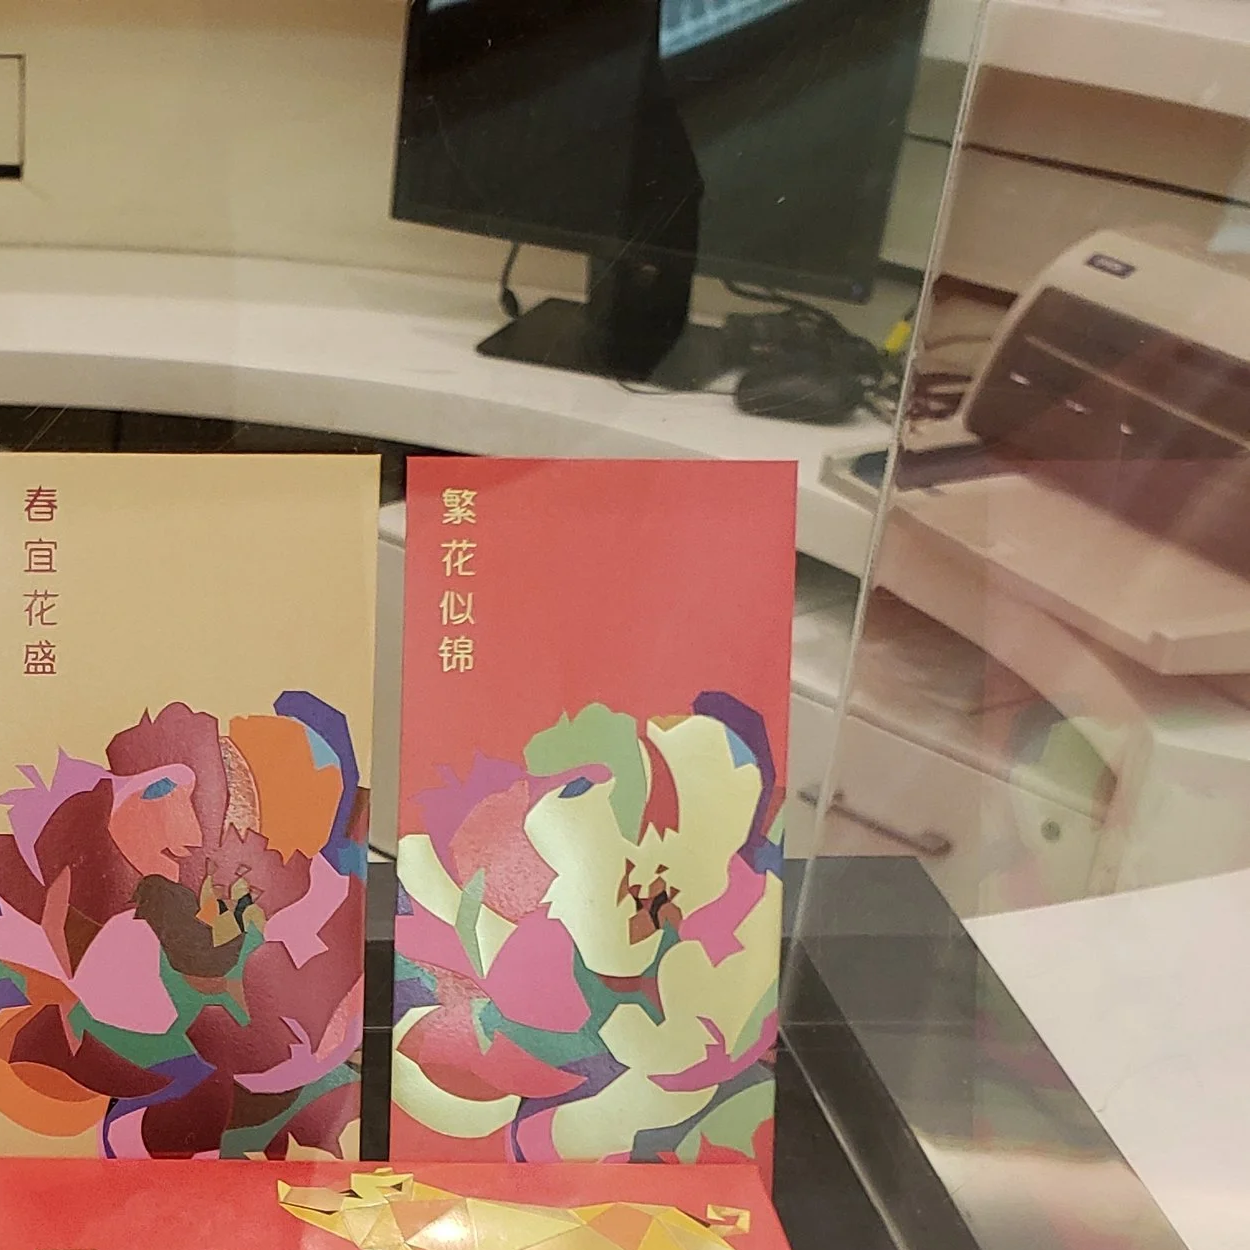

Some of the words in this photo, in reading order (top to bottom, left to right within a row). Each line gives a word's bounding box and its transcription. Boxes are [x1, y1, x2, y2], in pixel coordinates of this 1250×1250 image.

[23, 485, 60, 675] 春宜花盛
[438, 487, 478, 673] 繁花似锦
